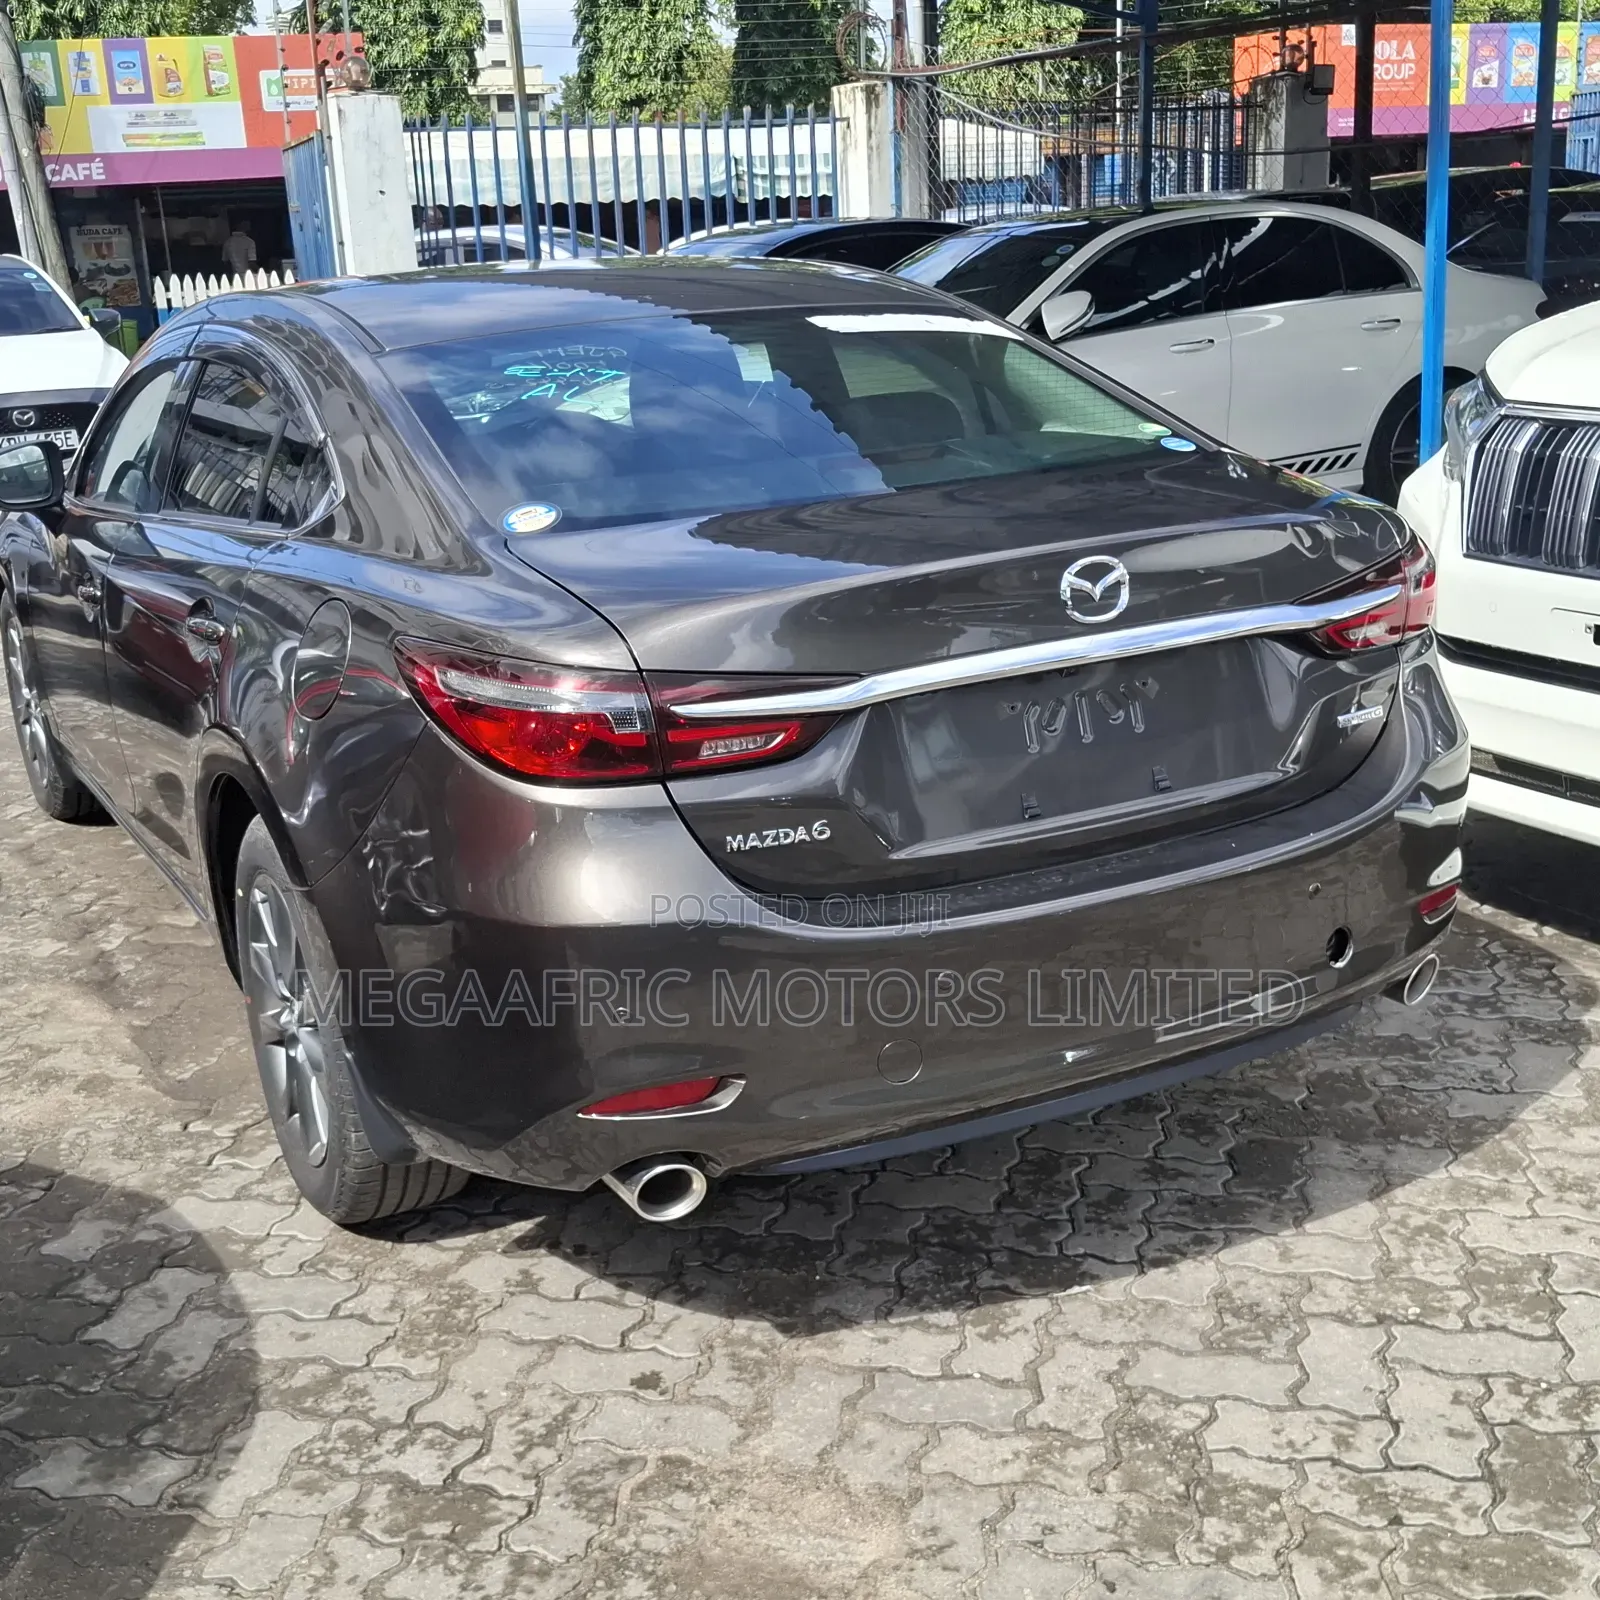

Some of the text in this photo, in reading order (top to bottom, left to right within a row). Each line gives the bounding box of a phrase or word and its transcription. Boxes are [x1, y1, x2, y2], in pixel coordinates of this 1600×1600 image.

[1374, 40, 1416, 60] OLA
[1373, 63, 1416, 80] ROUP
[45, 158, 106, 181] CAFÉ
